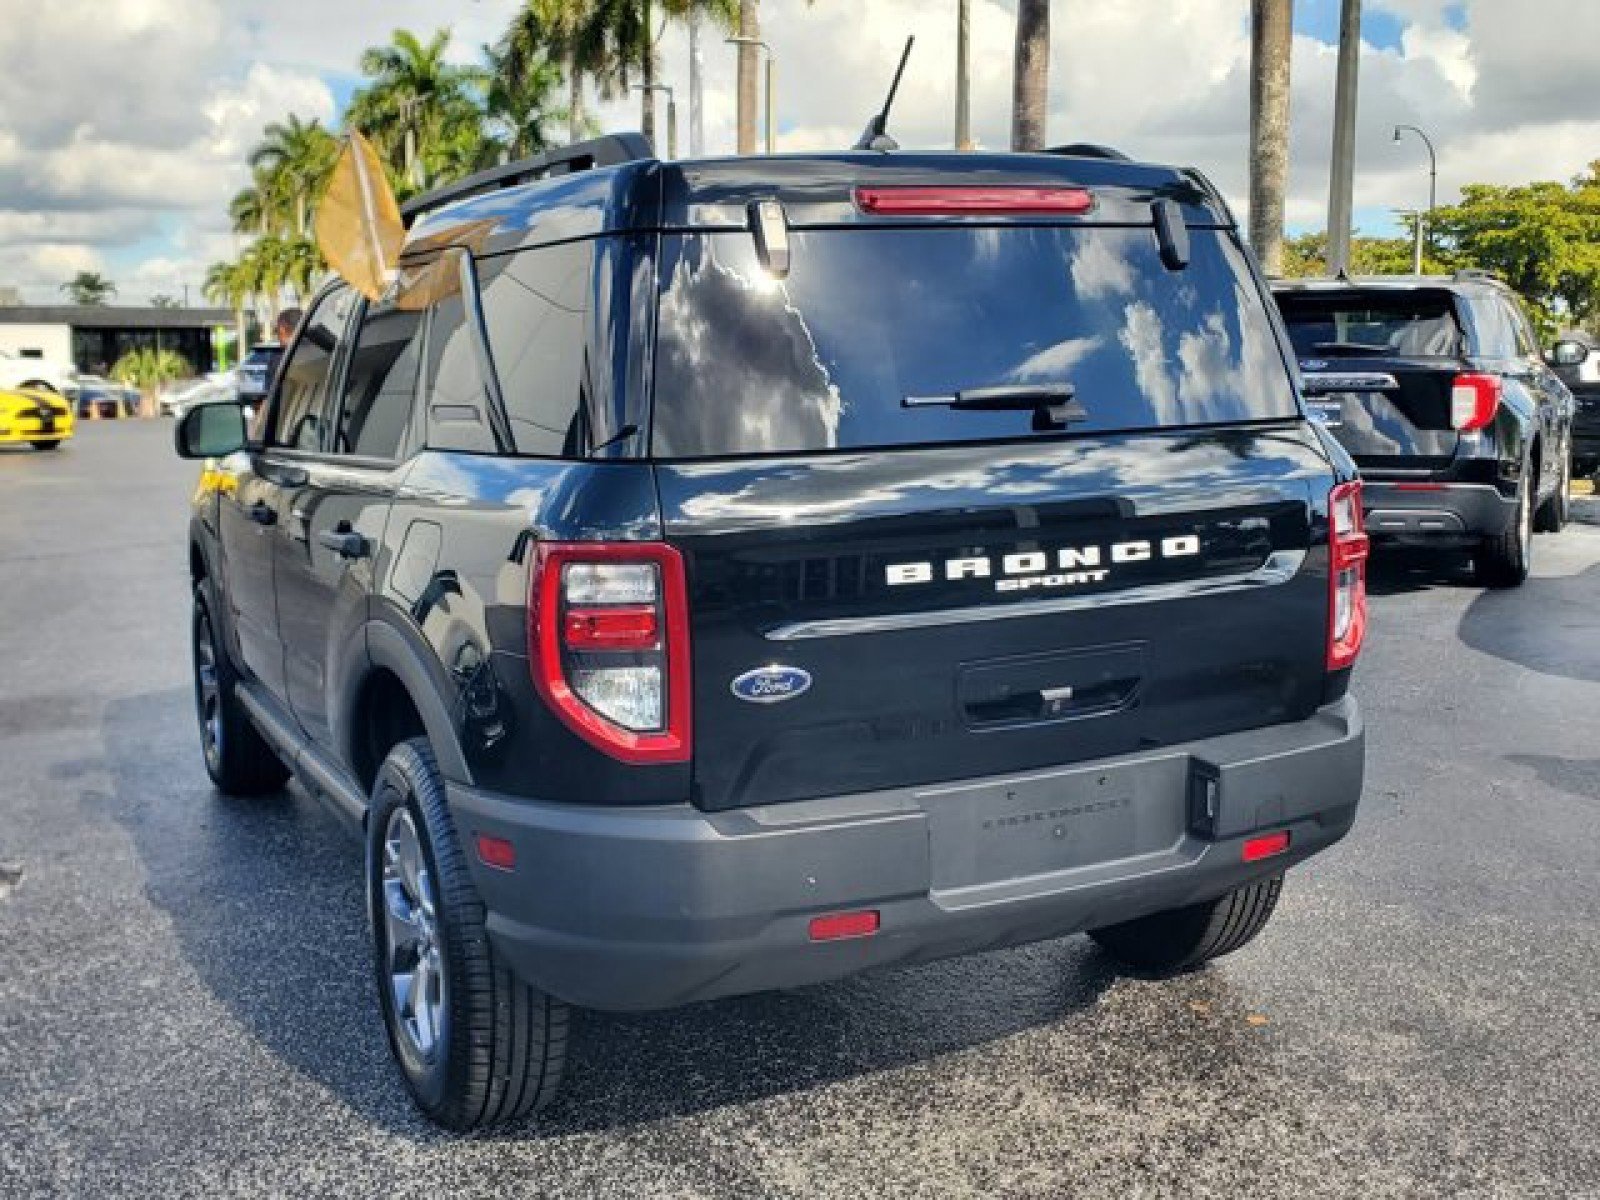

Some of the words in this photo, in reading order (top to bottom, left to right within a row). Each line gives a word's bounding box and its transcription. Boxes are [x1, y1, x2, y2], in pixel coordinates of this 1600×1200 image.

[885, 535, 1200, 585] BRONCO
[995, 569, 1110, 591] SPORT
[750, 672, 793, 696] Ford
